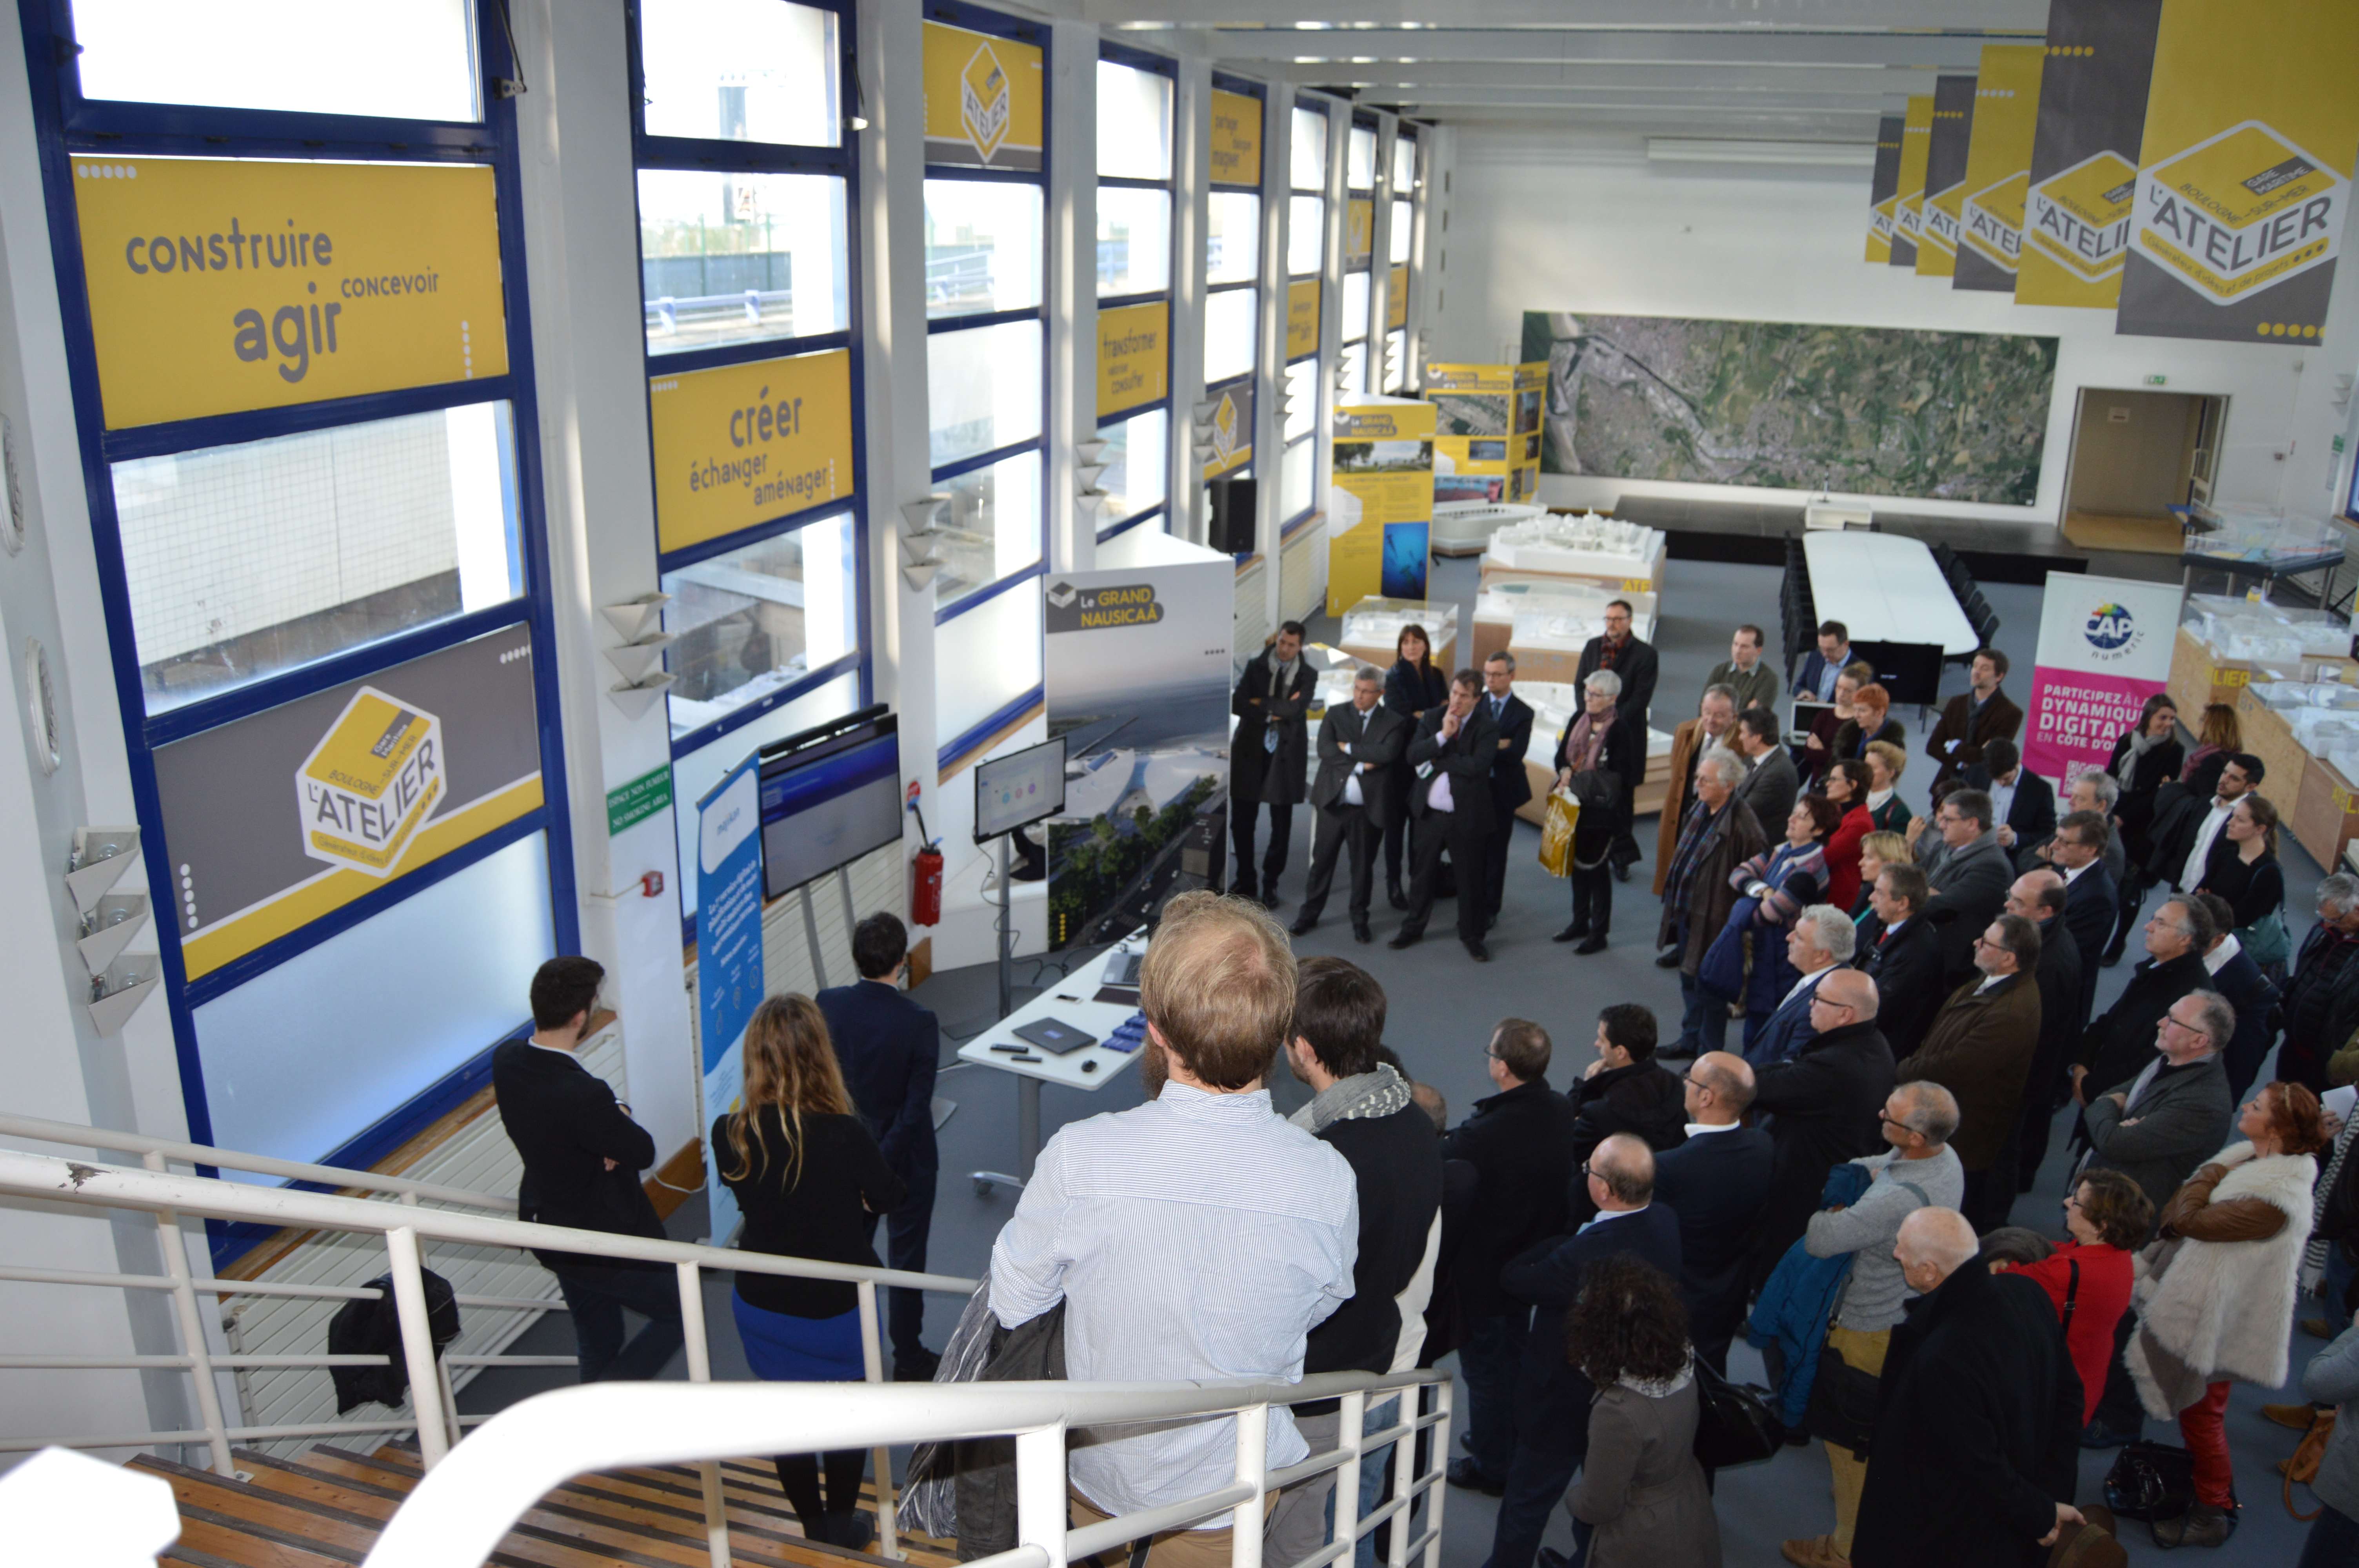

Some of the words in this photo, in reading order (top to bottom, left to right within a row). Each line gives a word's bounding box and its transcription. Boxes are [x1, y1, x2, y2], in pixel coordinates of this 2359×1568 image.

[2247, 169, 2280, 187] GARE
[2256, 166, 2310, 194] MARITIME
[2180, 183, 2242, 223] BOULOGNE
[2150, 184, 2332, 271] L'ATELIER
[2146, 236, 2194, 271] Générateur
[2225, 283, 2237, 294] et
[2239, 277, 2252, 288] de
[2254, 260, 2290, 283] projets
[233, 282, 342, 383] agir
[729, 385, 802, 448] créer
[690, 454, 767, 492] échanger
[754, 466, 827, 506] aménager
[1080, 595, 1094, 609] Le
[1098, 587, 1151, 607] GRAND
[2084, 615, 2134, 639] CAP
[2090, 630, 2146, 662] numeric
[2043, 684, 2122, 705] PARTICIPEZ
[2123, 692, 2132, 706] À
[374, 734, 391, 753] Gare
[2036, 731, 2053, 743] EN
[2056, 732, 2088, 748] CÔTE
[307, 739, 436, 843] L'ATELIER
[328, 769, 380, 796] BOULOGNE
[631, 783, 645, 796] NON
[612, 816, 623, 828] NO
